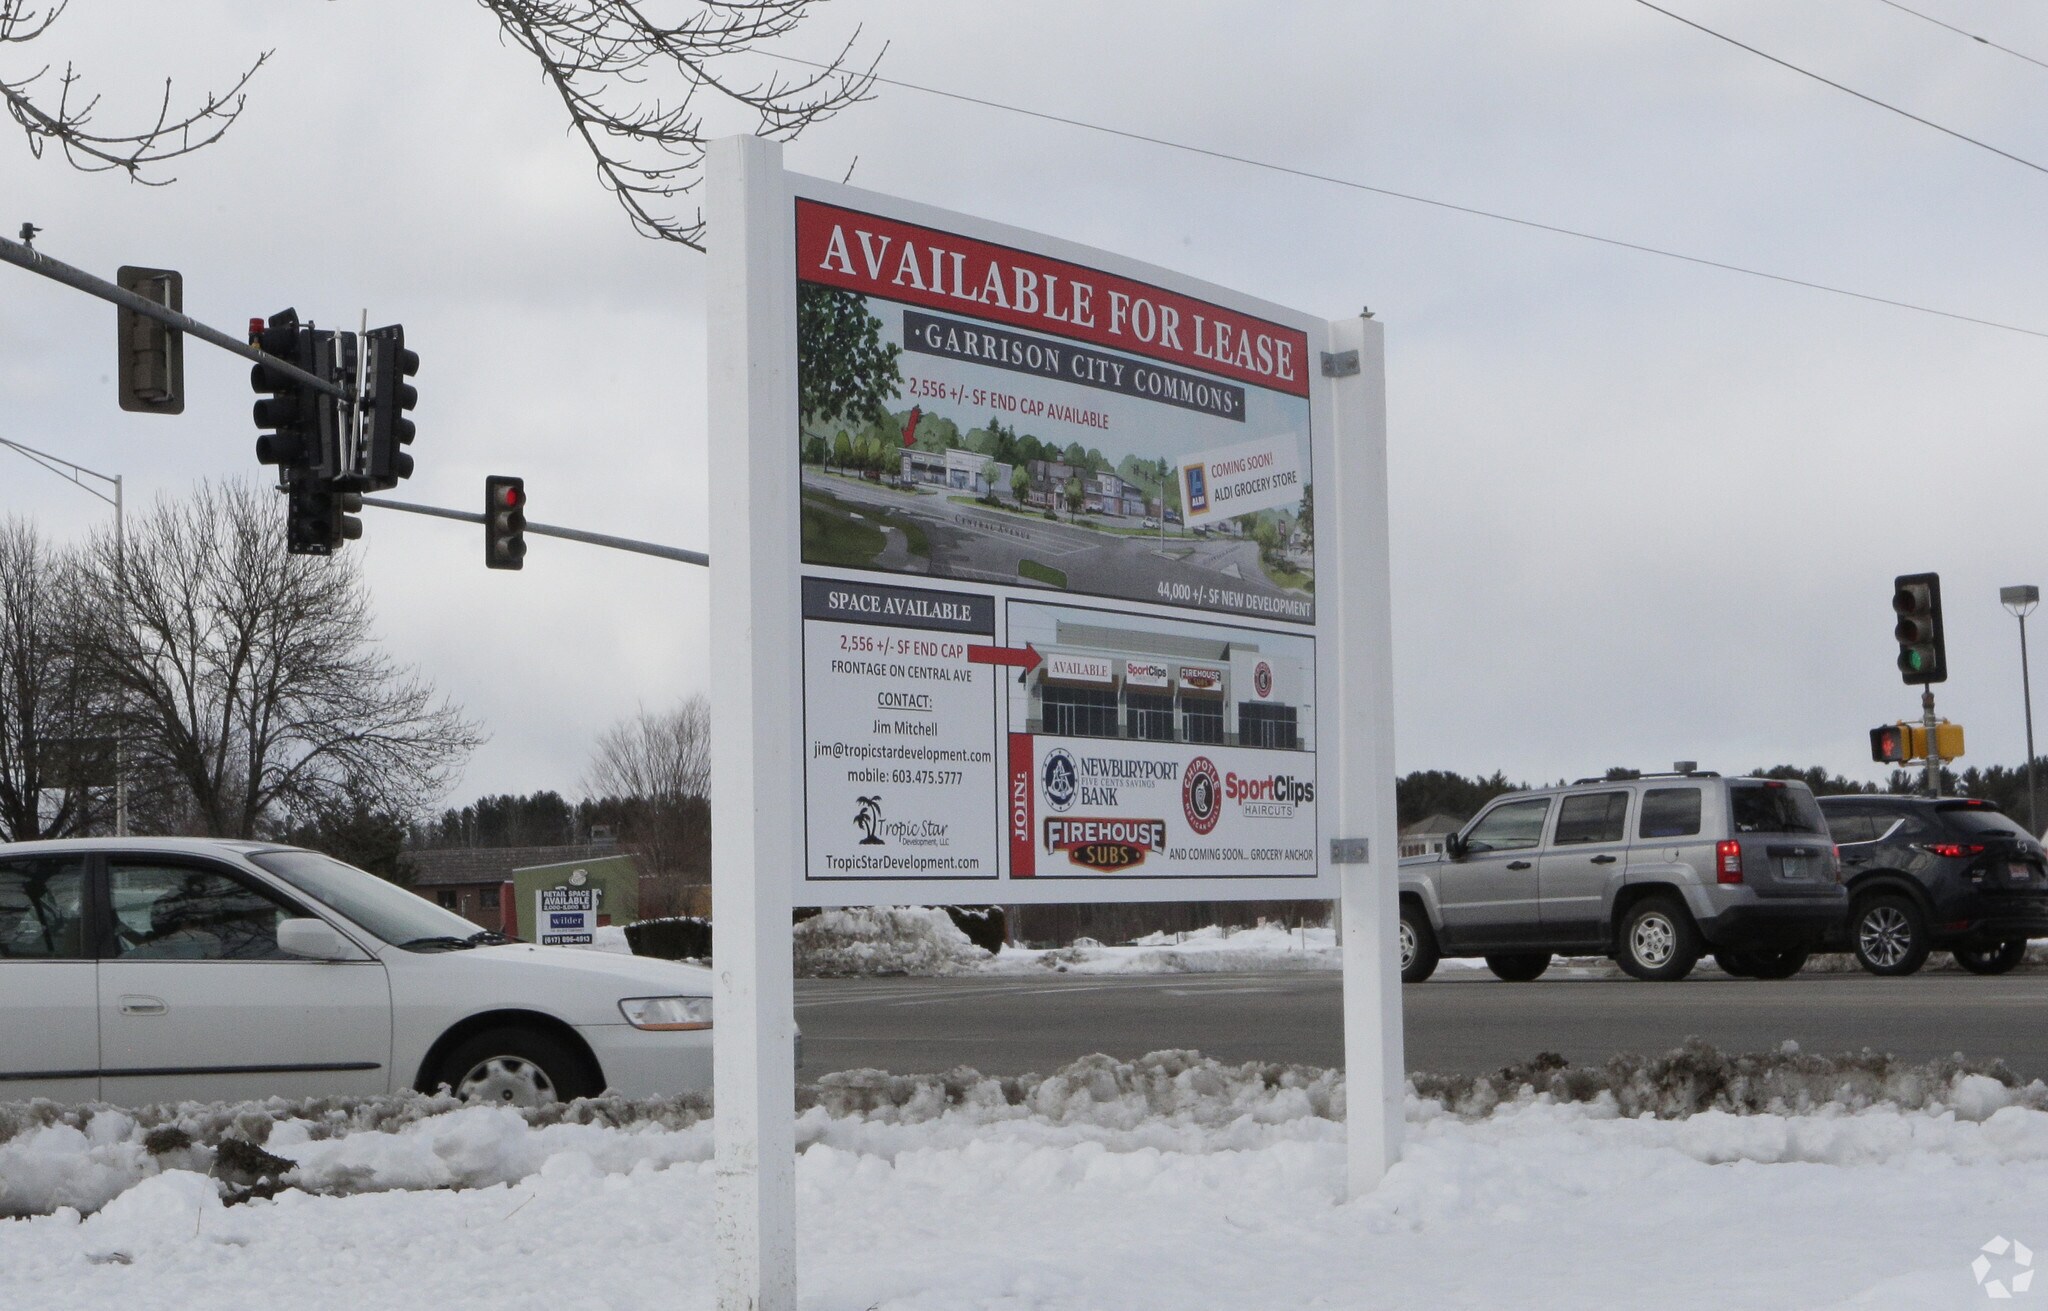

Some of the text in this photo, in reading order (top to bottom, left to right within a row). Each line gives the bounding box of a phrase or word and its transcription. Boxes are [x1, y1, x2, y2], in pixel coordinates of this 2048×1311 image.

[819, 224, 1294, 381] AVAILABLE FOR LEASE
[1072, 354, 1123, 387] CITY
[909, 377, 1109, 430] 2,556 +/- SF END CAP AVAILABLE
[1211, 452, 1273, 478] COMING SOON!
[1214, 470, 1297, 502] ALDI GROCERY STORE
[828, 591, 972, 622] SPACE AVAILABLE
[1157, 581, 1311, 617] 44,000 +/- SF NEW DEVELOPMENT
[840, 634, 963, 659] 2,556 +/- SF END CAP
[831, 660, 972, 682] FRONTAGE ON CENTRAL AVE
[1052, 660, 1108, 677] AVAILABLE
[1127, 663, 1167, 679] SportClips
[1181, 668, 1220, 682] FIREHOUSE
[878, 691, 933, 710] CONTACT:
[873, 719, 938, 736] Jim Mitchell
[814, 741, 992, 764] jim@tropicstardevelopment.com
[848, 768, 963, 785] mobile: 603.475.5777
[1081, 757, 1179, 780] NEWBURYPORT
[1184, 760, 1220, 790] CHIPOTLE
[1081, 777, 1155, 788] FIVE CENTS SAVINGS
[1225, 771, 1314, 807] SportClips
[1013, 771, 1028, 842] JOIN:
[1081, 787, 1118, 806] BANK
[1244, 804, 1293, 816] HAIRCUTS
[877, 818, 948, 843] Tropic Star
[902, 837, 949, 846] Development, LLC
[1048, 821, 1165, 855] FIREHOUSE
[826, 854, 979, 872] TropicStarDevelopment.com
[1087, 845, 1129, 864] SUBS
[1169, 848, 1314, 861] AND COMING SOON... GROCERY ANCHOR
[552, 916, 583, 925] wilder
